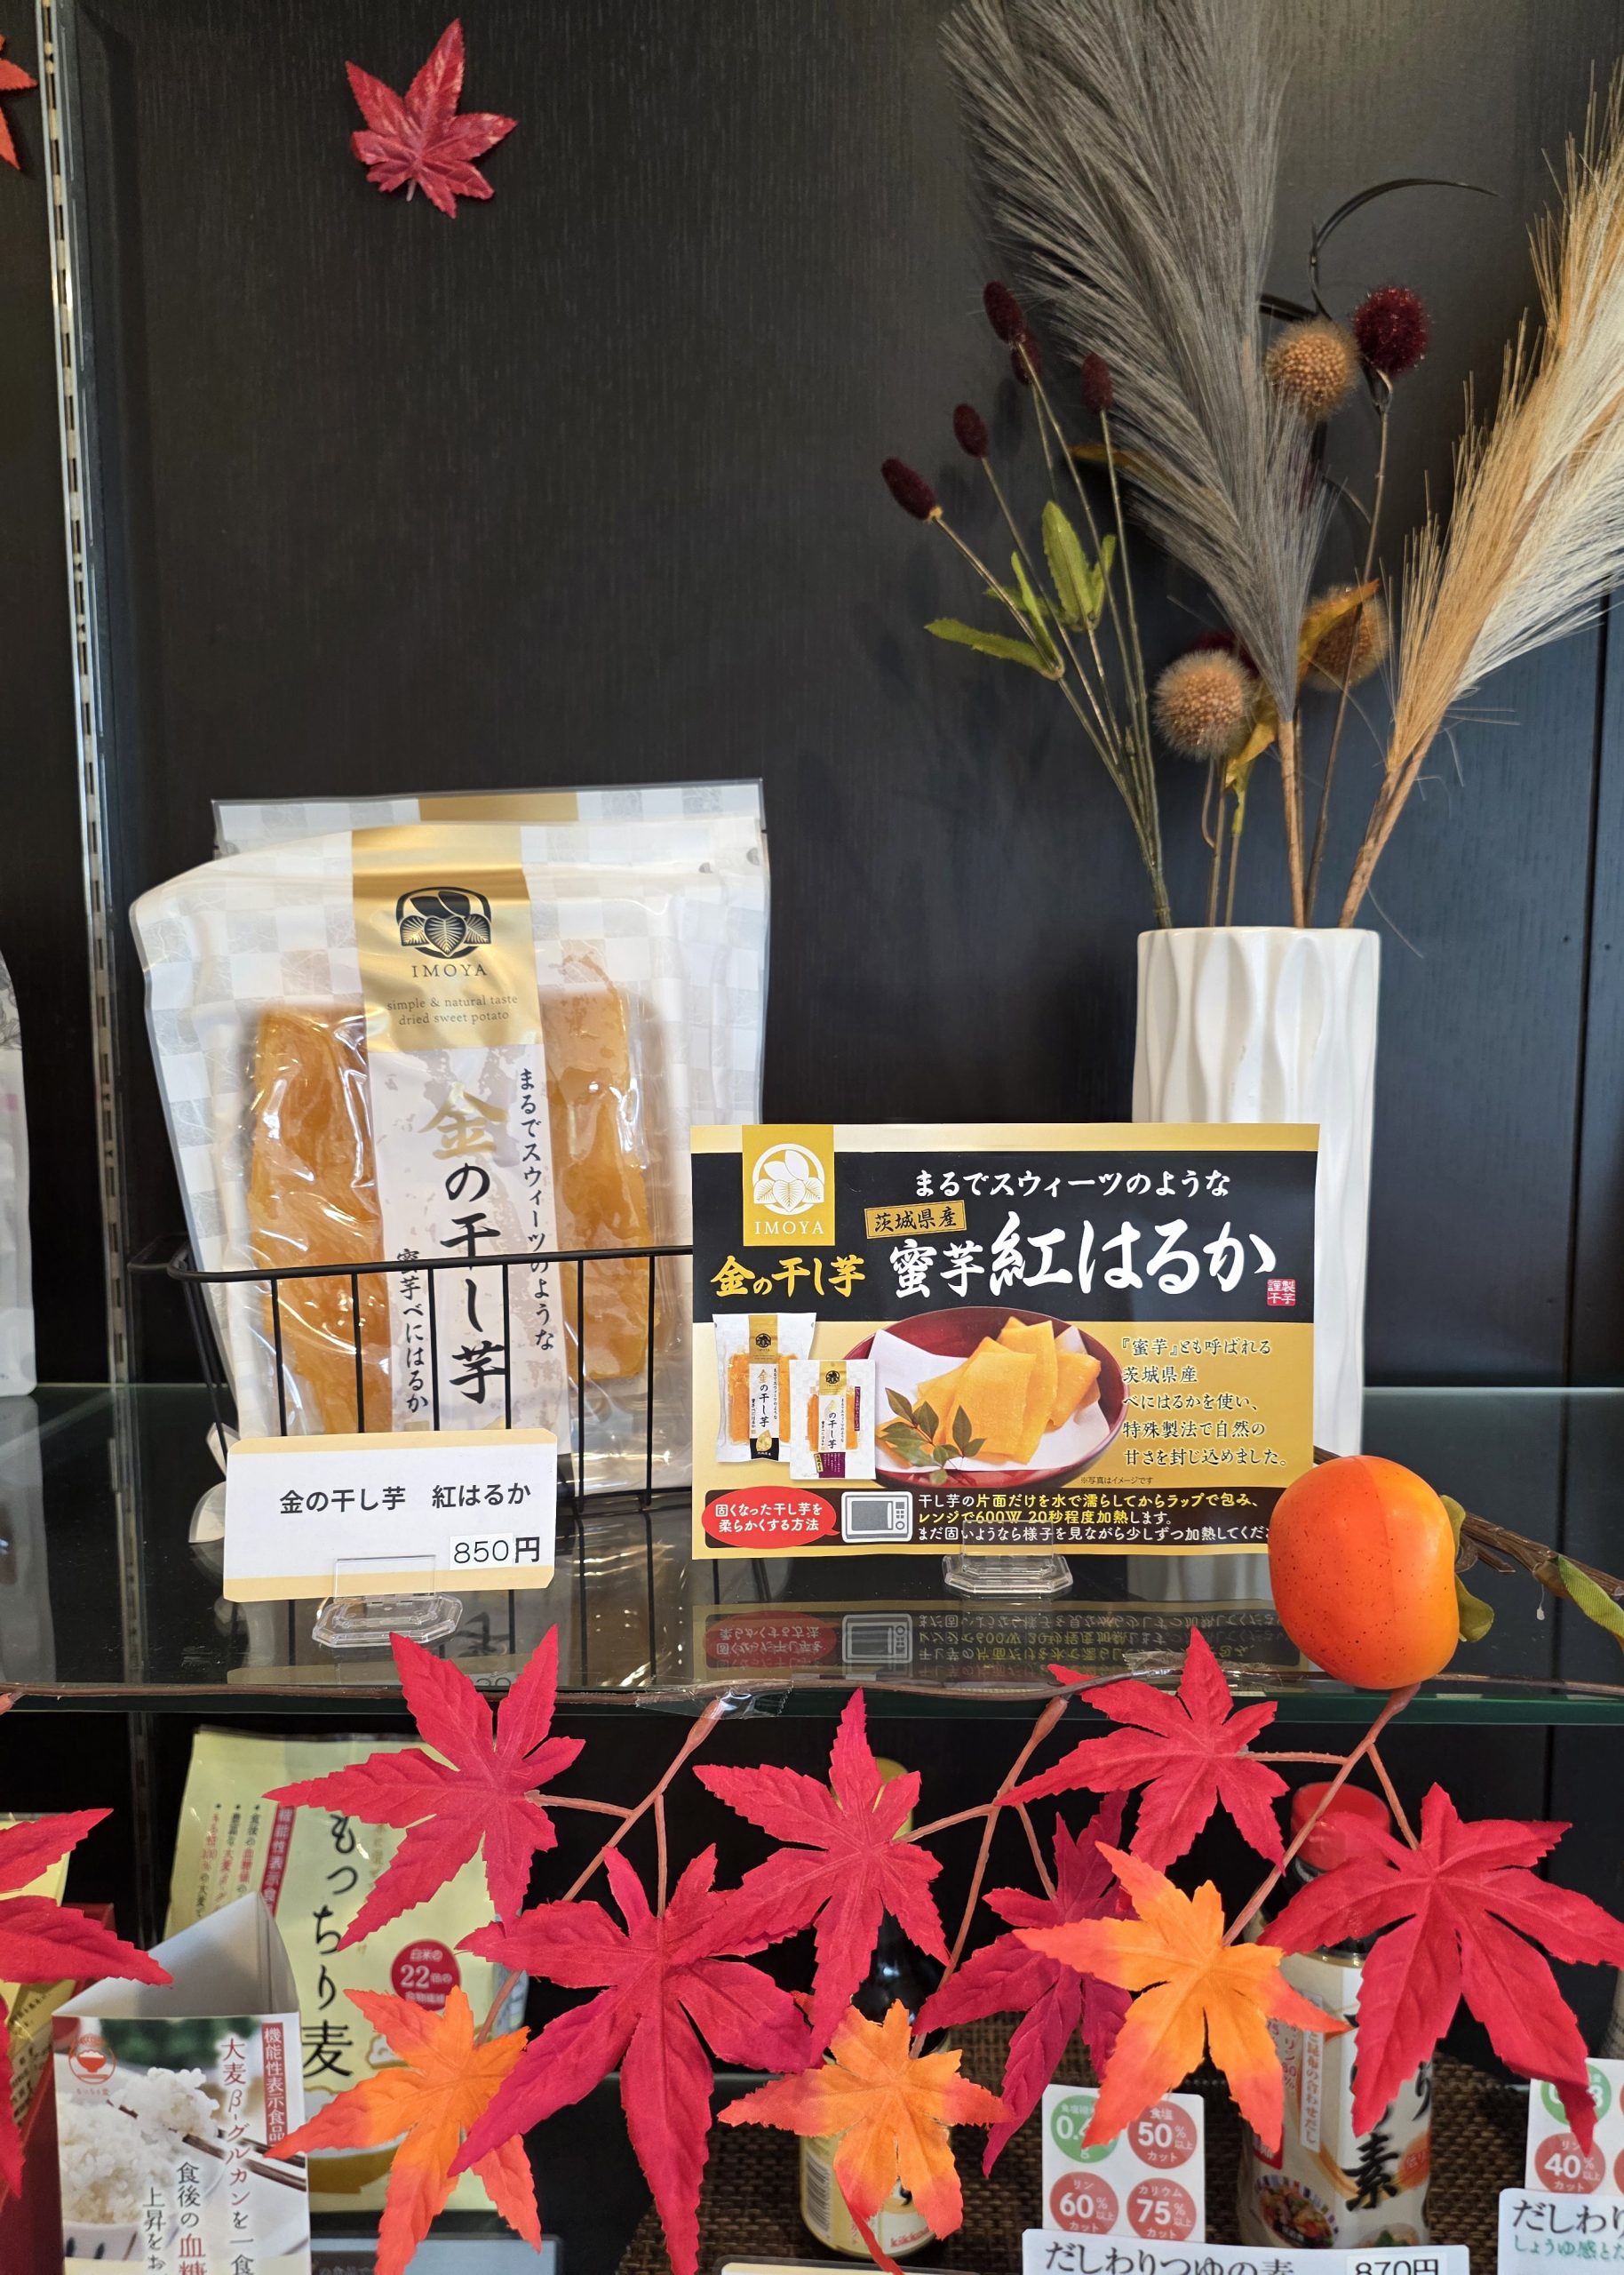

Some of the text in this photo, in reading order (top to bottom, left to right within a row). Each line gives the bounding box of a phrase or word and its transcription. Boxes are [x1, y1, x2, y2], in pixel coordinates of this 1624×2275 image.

[411, 964, 488, 978] IMOYA
[386, 994, 518, 1011] simple & natural taste
[398, 1010, 509, 1026] dried sweet potato
[916, 1169, 1230, 1197] まるでスウィーツのような
[520, 1068, 555, 1351] まるでスウィーツのような
[754, 1221, 824, 1234] IMOYA
[874, 1207, 957, 1233] 茨城県産
[418, 1081, 507, 1405] 金の干し芋
[889, 1211, 1276, 1297] 蜜芋紅はるか
[711, 1255, 865, 1297] 金の干し芋
[1122, 1337, 1271, 1356] 『蜜芋』とも呼ばれる
[1123, 1366, 1198, 1384] 茨城県産
[1123, 1393, 1258, 1410] べにはるかを使い、
[1123, 1420, 1265, 1438] 特殊製法で自然の
[1124, 1449, 1287, 1466] 甘さを封じ込めました。
[280, 1482, 531, 1514] 金の干し芋 紅はるか
[918, 1492, 1258, 1508] 干し芋の片面だけを水で濡らしてからラップで包み、
[715, 1502, 823, 1518] 固くなった干し芋を
[918, 1510, 1173, 1525] レンジで600W 20秒程度加熱します。
[718, 1518, 819, 1533] 柔らかくする方法
[918, 1526, 1270, 1542] まだ固いようなら様子を見ながら少しずつ加熱してくだ
[453, 1537, 540, 1564] 850円
[301, 1814, 359, 2078] もっちり麦
[264, 2027, 285, 2142] 機能性表示食品
[1147, 2151, 1178, 2162] カット
[1073, 2179, 1095, 2190] リン
[1138, 2185, 1182, 2198] カリウム
[1554, 2180, 1585, 2191] カット
[141, 2186, 167, 2275] 上昇をお
[1069, 2220, 1099, 2232] カット
[1146, 2227, 1177, 2239] カット
